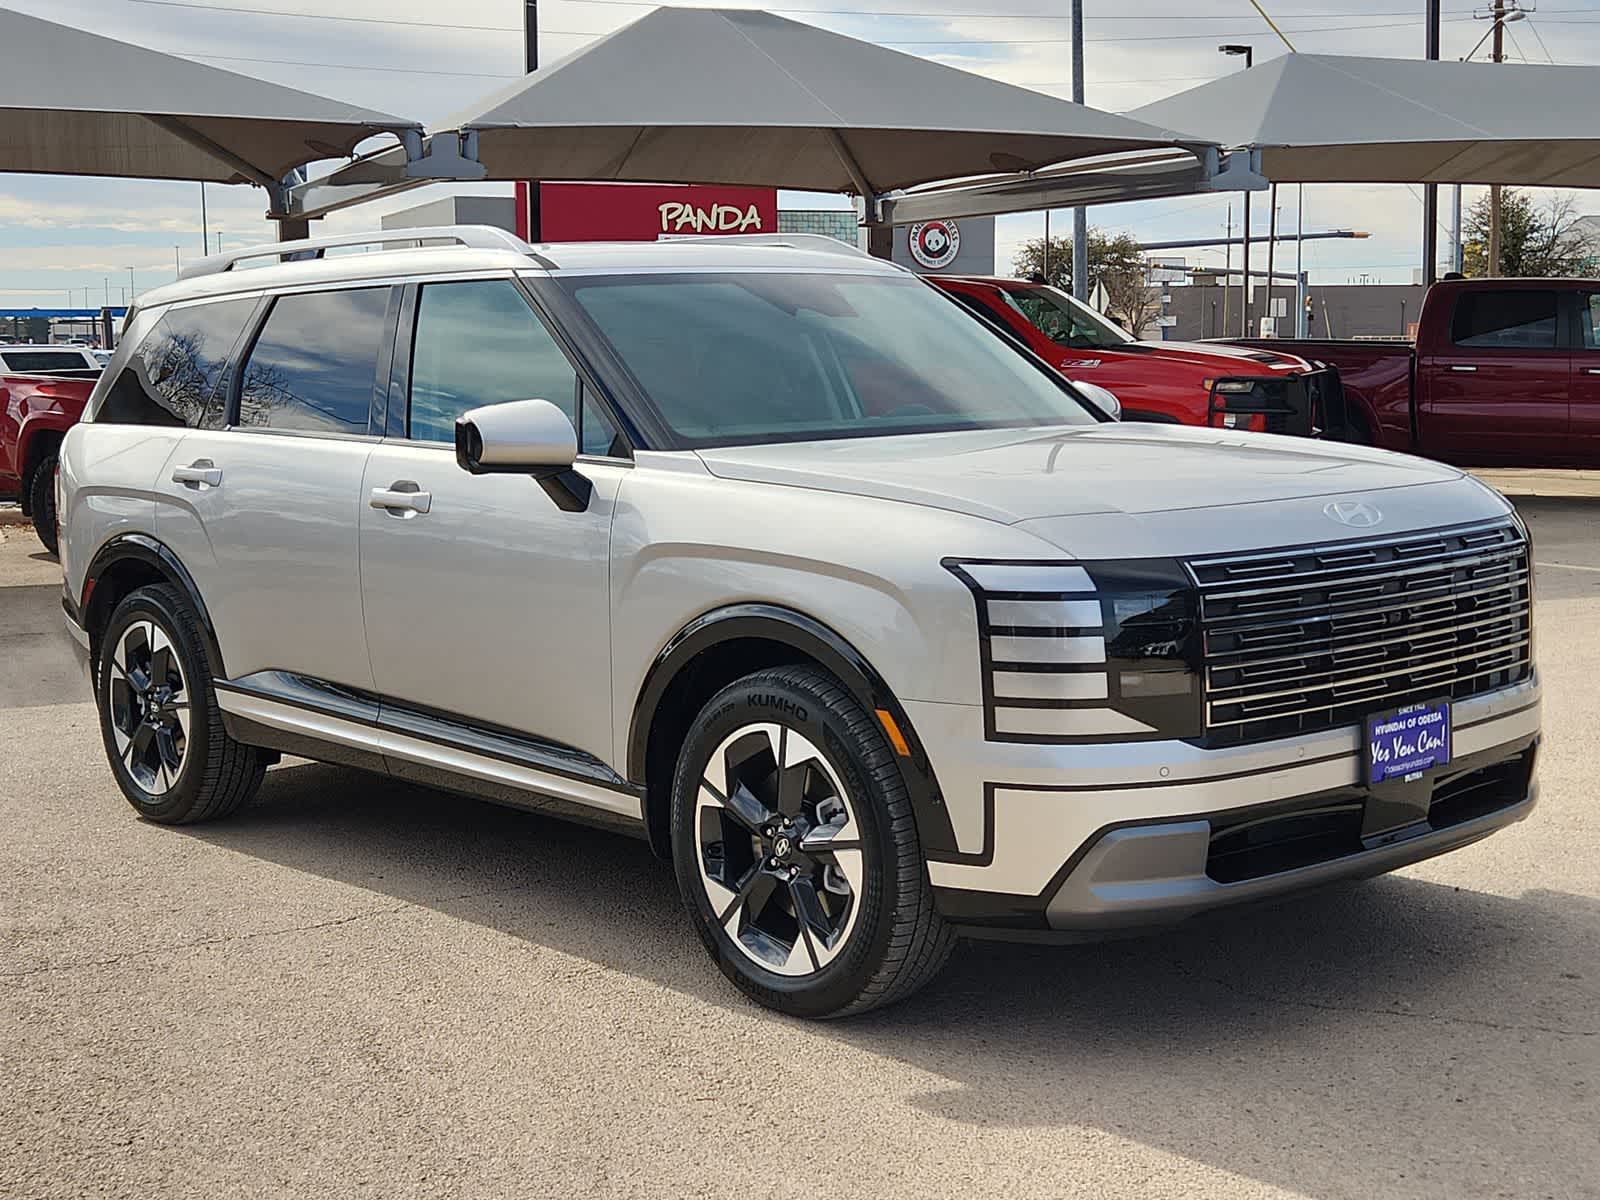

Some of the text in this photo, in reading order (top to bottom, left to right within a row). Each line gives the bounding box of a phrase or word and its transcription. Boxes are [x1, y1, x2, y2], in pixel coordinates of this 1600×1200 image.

[658, 202, 761, 233] PANDA
[747, 693, 808, 721] KUMHO
[1375, 711, 1443, 736] HYUNDAI OF ODESSA
[1371, 724, 1446, 765] Yes You Can!
